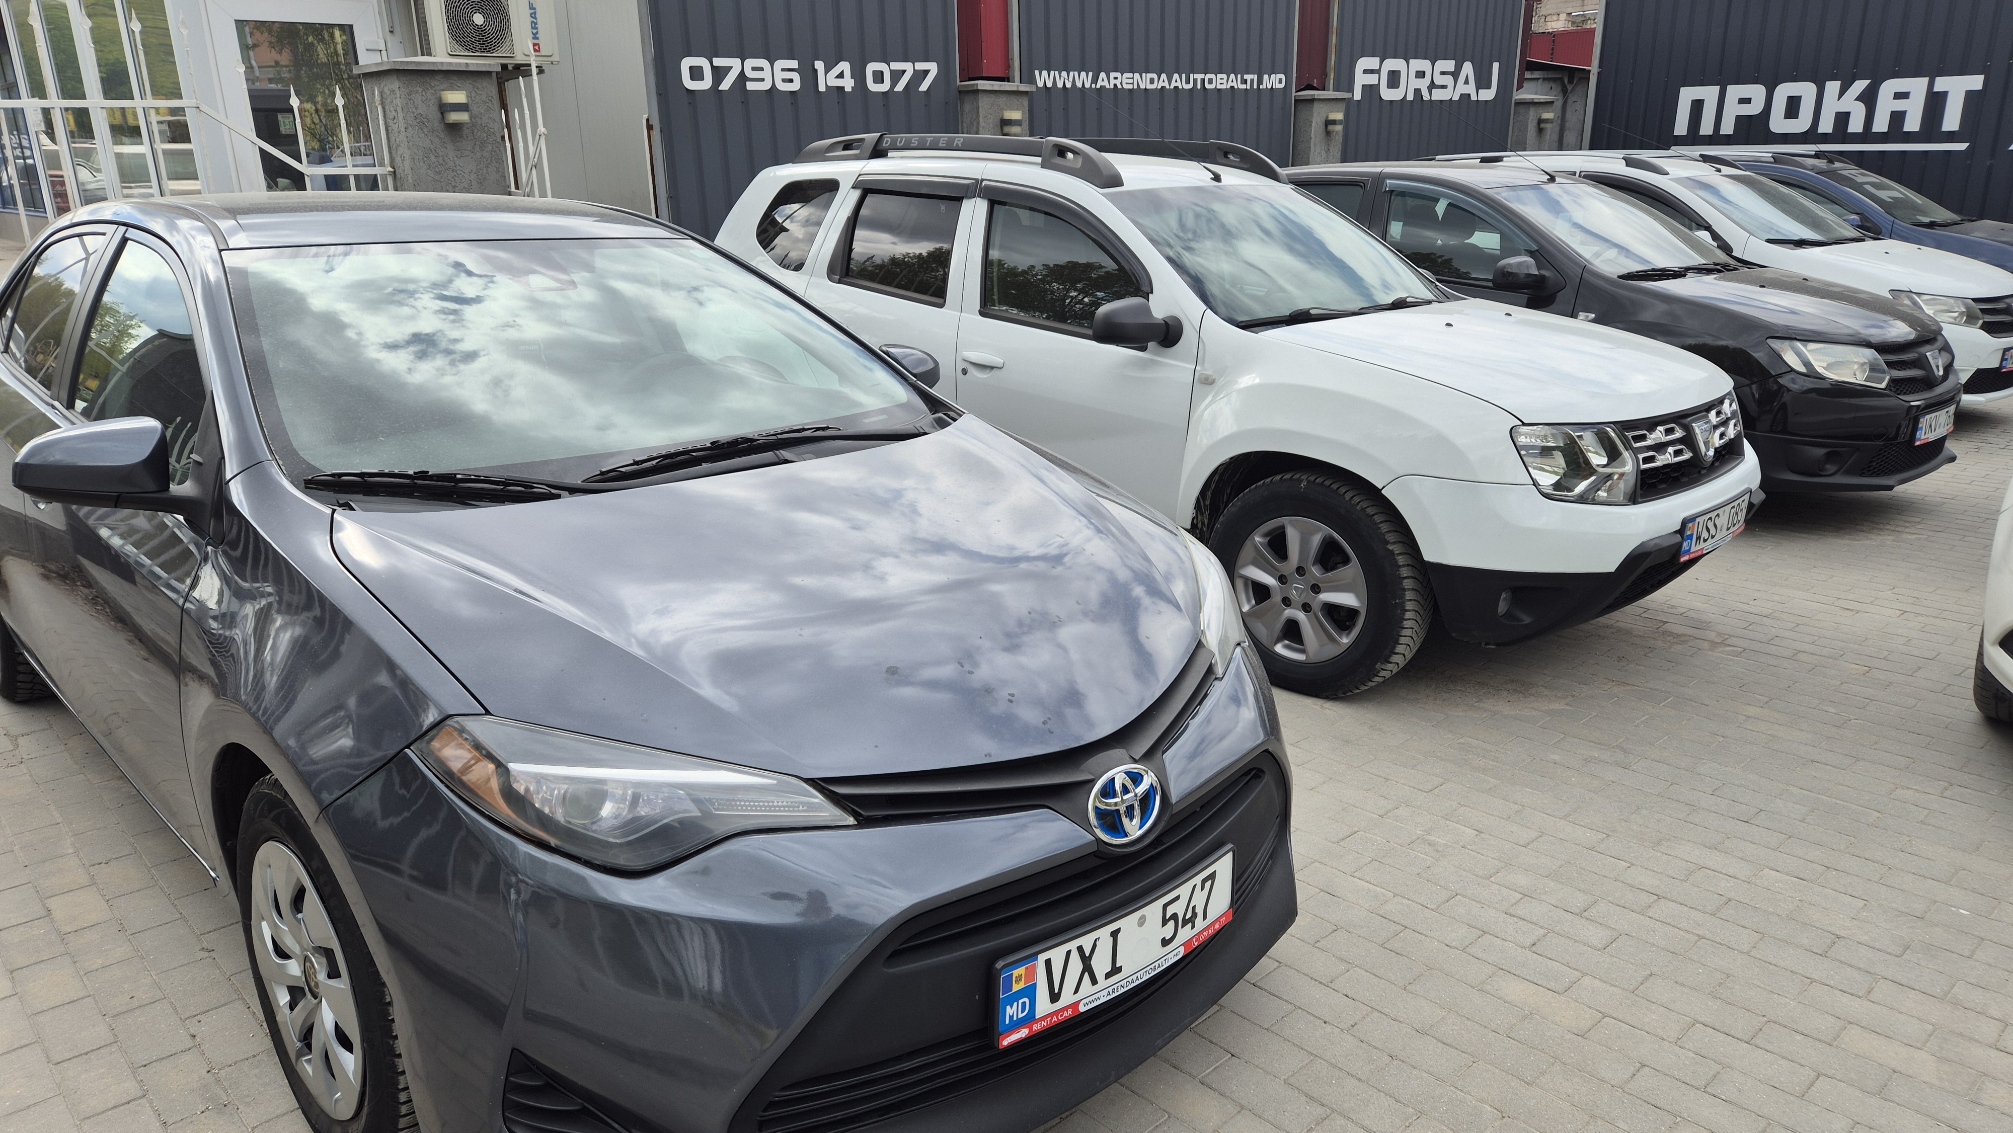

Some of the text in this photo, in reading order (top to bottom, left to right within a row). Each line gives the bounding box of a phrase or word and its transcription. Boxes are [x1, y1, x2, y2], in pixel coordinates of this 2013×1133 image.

[680, 56, 938, 92] 0796 14 077
[1034, 69, 1286, 90] WWW.ARENDAAUTOBALTI.MD
[1353, 56, 1500, 101] FORSAJ
[1673, 74, 1985, 136] ПРОКАТ
[882, 137, 964, 147] DUSTER
[1694, 512, 1720, 547] WSS
[1044, 869, 1217, 1005] VXI 547
[1005, 997, 1030, 1025] MD
[1032, 1008, 1073, 1032] RENT A CAR
